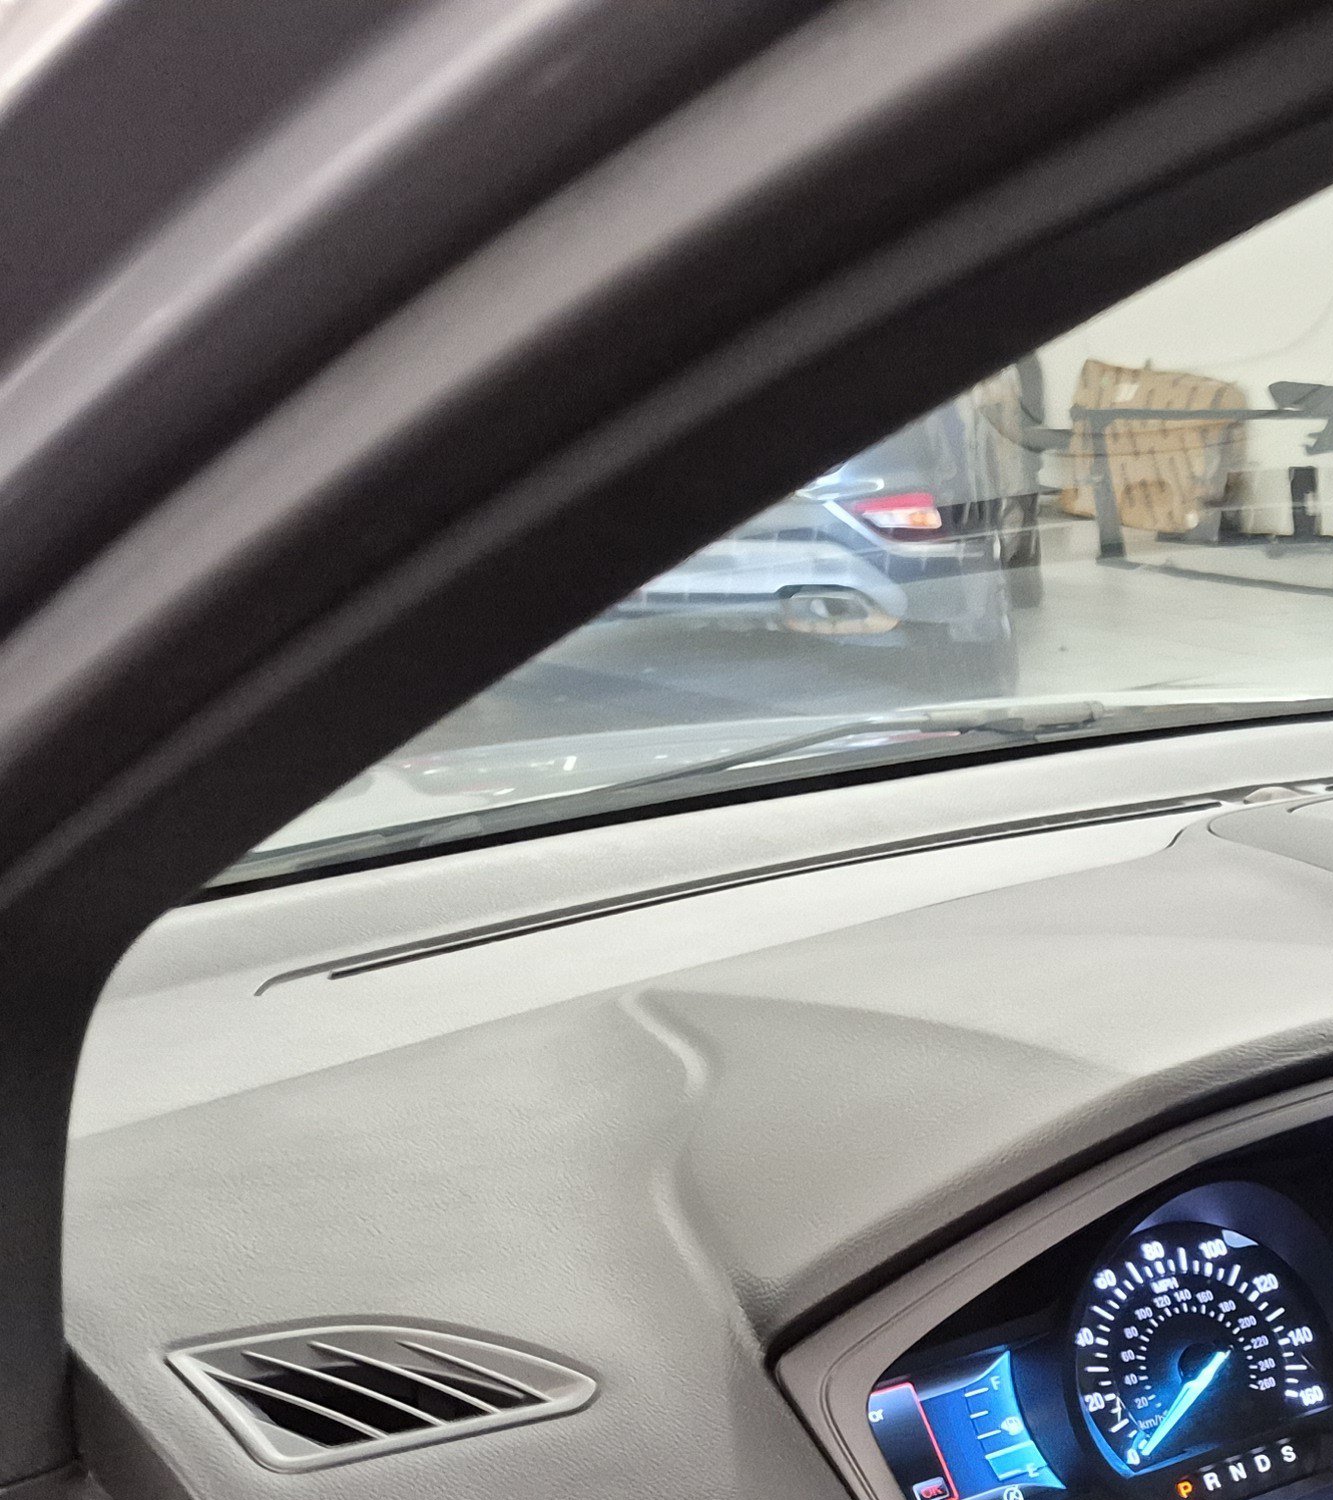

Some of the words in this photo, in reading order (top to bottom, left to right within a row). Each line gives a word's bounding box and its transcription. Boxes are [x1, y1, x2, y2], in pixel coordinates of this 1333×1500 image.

[1141, 1241, 1165, 1260] 80
[1198, 1239, 1228, 1259] 100
[1094, 1269, 1117, 1289] 60
[1252, 1273, 1279, 1293] 120
[1153, 1294, 1172, 1309] 120
[1173, 1288, 1192, 1302] 140
[1196, 1290, 1214, 1303] 160
[1134, 1306, 1153, 1320] 100
[1218, 1300, 1236, 1313] 180
[1238, 1315, 1257, 1330] 200
[1075, 1327, 1094, 1347] 40
[1124, 1326, 1139, 1339] 80
[1288, 1326, 1313, 1346] 140
[1251, 1335, 1269, 1349] 220
[1121, 1349, 1135, 1362] 60
[1257, 1357, 1276, 1372] 240
[991, 1375, 1001, 1390] F
[1124, 1373, 1138, 1386] 40
[1257, 1376, 1276, 1391] 260
[1084, 1392, 1105, 1412] 20
[1134, 1396, 1149, 1409] 20
[1299, 1385, 1325, 1406] 160
[1026, 1462, 1040, 1478] E
[1175, 1480, 1193, 1499] P
[1202, 1472, 1222, 1491] R
[1228, 1462, 1247, 1482] N
[1254, 1454, 1271, 1473] D
[1280, 1445, 1297, 1463] S
[920, 1487, 945, 1499] OK
